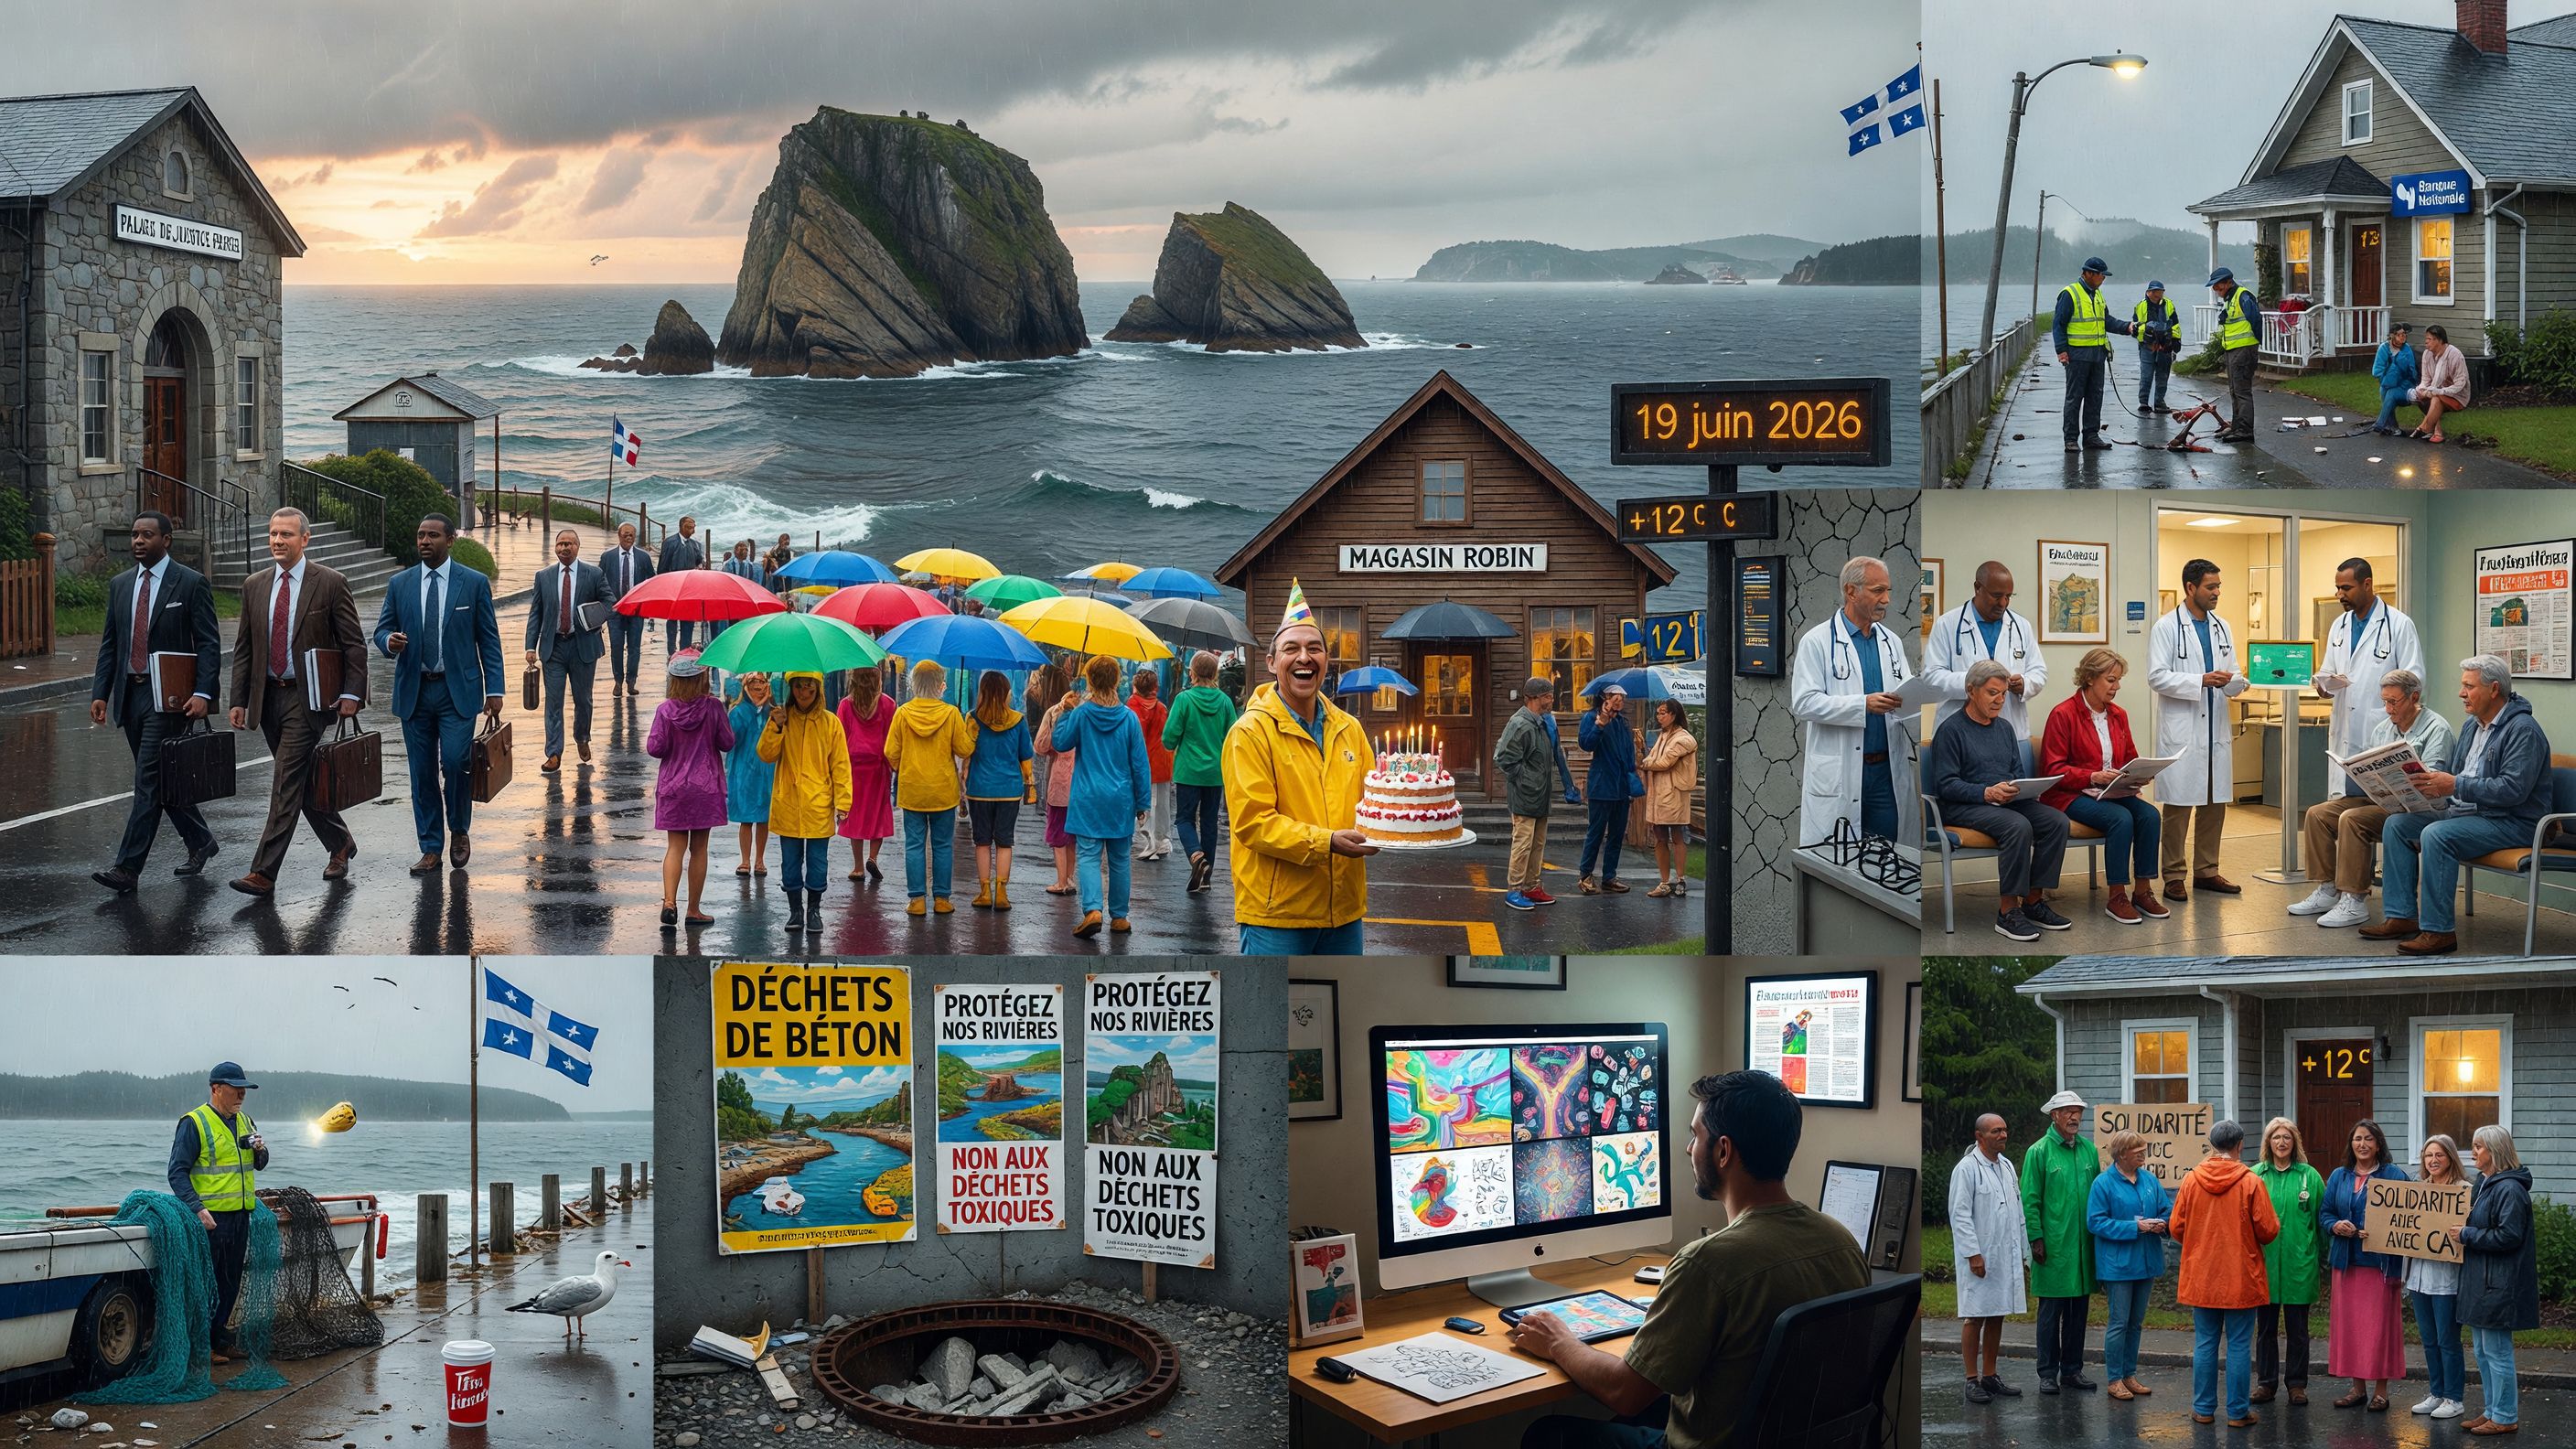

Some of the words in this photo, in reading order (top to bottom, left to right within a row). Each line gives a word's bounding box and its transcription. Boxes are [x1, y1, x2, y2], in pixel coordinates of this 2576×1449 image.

[1637, 403, 1678, 440] 19
[1688, 402, 1754, 449] juin
[1768, 401, 1862, 439] 2026
[1349, 547, 1453, 569] MAGASIN
[1464, 547, 1534, 568] ROBIN
[732, 966, 893, 1013] DÉCHETS
[945, 988, 1054, 1017] PROTÉGEZ
[1093, 974, 1212, 1007] PROTÉGEZ
[942, 1021, 977, 1040] NOS
[1091, 1011, 1126, 1031] NOS
[1132, 1008, 1214, 1031] RIVIÈRES
[726, 1021, 773, 1058] DE
[786, 1014, 901, 1057] BÉTON
[952, 1147, 997, 1170] NON
[1004, 1146, 1049, 1169] AUX
[1099, 1150, 1146, 1176] NON
[1154, 1154, 1202, 1181] AUX
[952, 1171, 1048, 1197] DÉCHETS
[1099, 1177, 1200, 1211] DÉCHETS
[949, 1199, 1054, 1225] TOXIQUES
[2371, 1185, 2465, 1215] SOLIDARITÉ
[1093, 1208, 1206, 1241] TOXIQUES
[2386, 1230, 2420, 1250] AVEC
